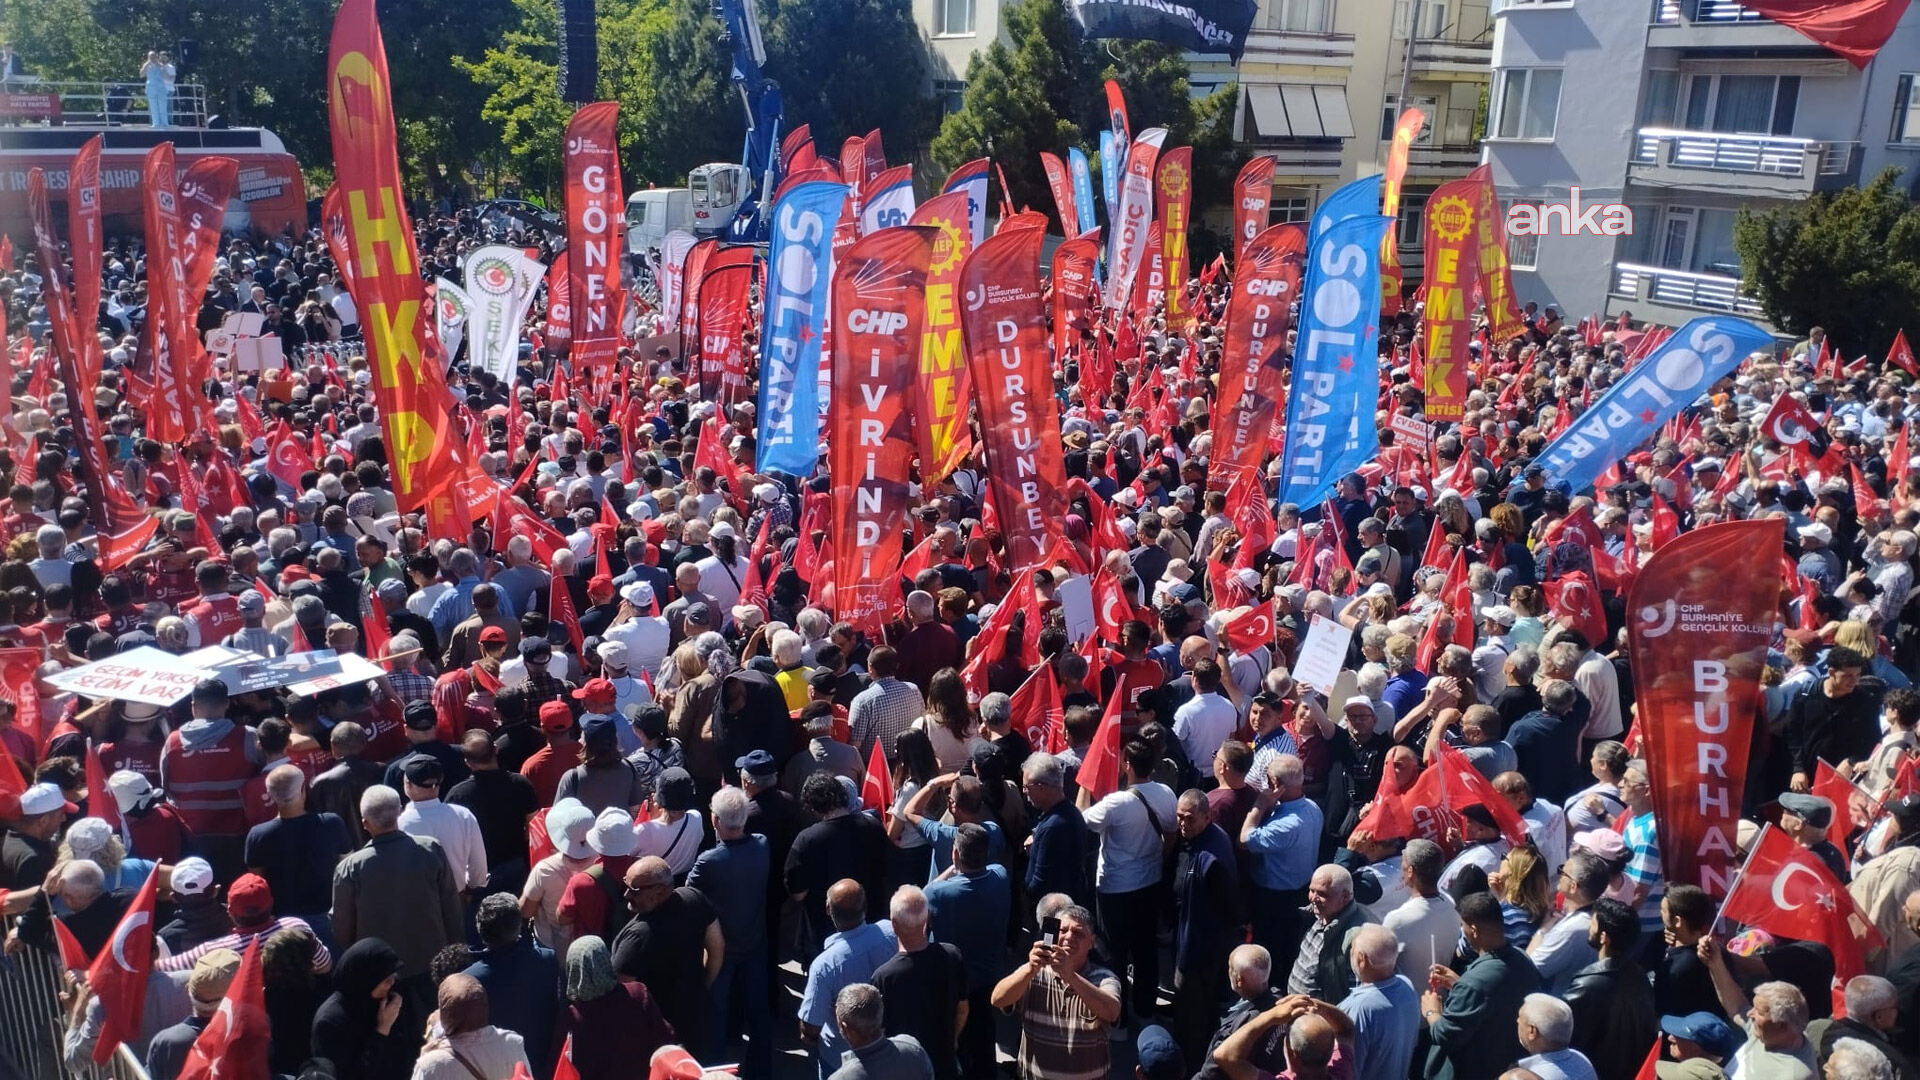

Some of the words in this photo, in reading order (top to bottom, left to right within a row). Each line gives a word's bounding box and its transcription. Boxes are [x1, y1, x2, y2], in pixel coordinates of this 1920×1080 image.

[1242, 197, 1266, 211] CHP
[1441, 213, 1466, 224] EMEP
[582, 165, 608, 333] GÖNEN
[774, 203, 823, 328] SOL
[932, 240, 953, 253] MEP
[1062, 270, 1083, 281] CHP
[848, 308, 909, 335] CHP
[1246, 278, 1289, 297] CHP
[1307, 240, 1367, 361] SOL
[1425, 248, 1466, 397] EMEK
[349, 187, 436, 495] HKP
[921, 283, 966, 465] EMEK
[1622, 322, 1735, 409] SOL
[1231, 303, 1271, 461] DURSUNBEY
[1426, 402, 1463, 416] RTİSİ
[856, 348, 888, 578] İVRİNDİ
[996, 320, 1049, 556] DURSUNBEY
[1290, 371, 1335, 486] PARTİ
[1549, 402, 1634, 478] PART
[1680, 604, 1704, 613] CHP
[1681, 611, 1744, 622] BURHANİYE
[1681, 622, 1729, 634] GENÇLİK
[139, 684, 185, 699] VAR
[1693, 660, 1737, 896] BURHAN
[1413, 804, 1439, 843] CH
